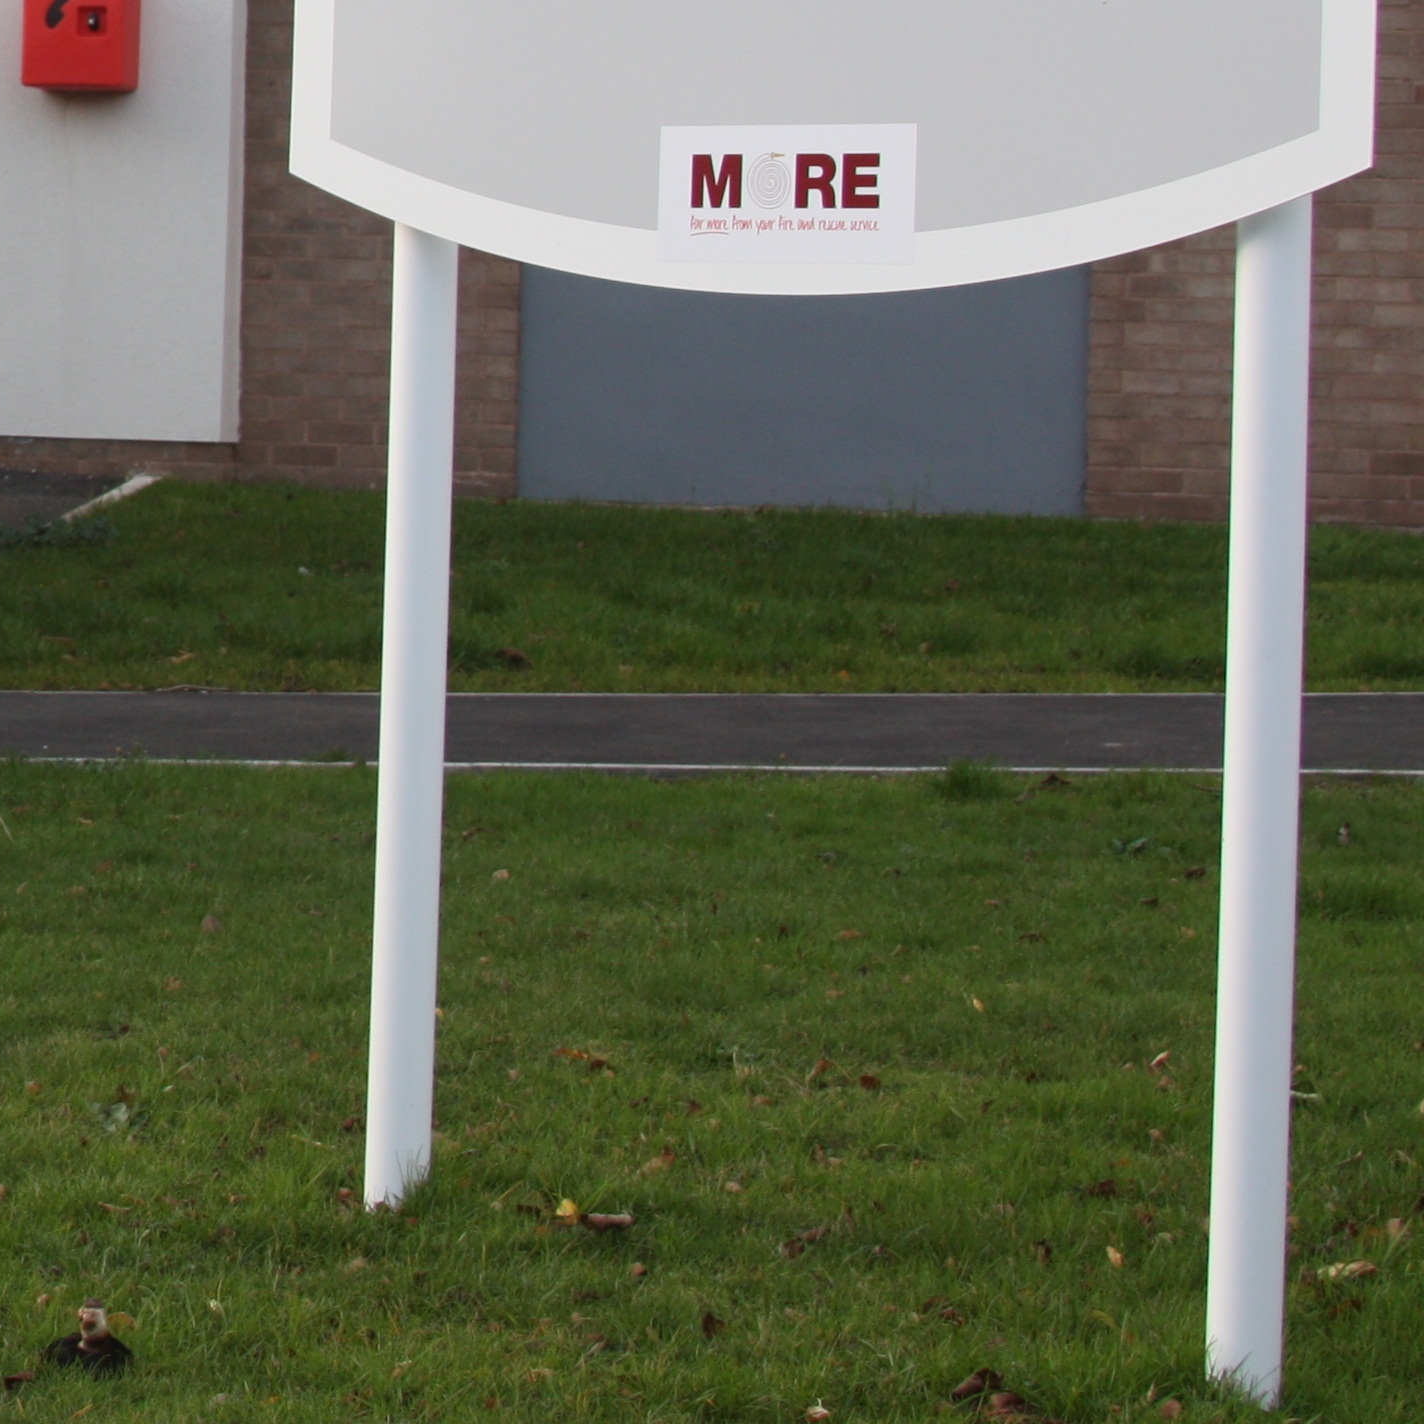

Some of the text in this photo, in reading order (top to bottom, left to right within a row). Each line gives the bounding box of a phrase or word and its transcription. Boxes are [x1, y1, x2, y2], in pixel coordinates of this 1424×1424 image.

[690, 151, 881, 209] MORE
[707, 218, 729, 231] more
[756, 219, 775, 235] your
[797, 217, 815, 231] and
[818, 219, 847, 231] rescue
[849, 217, 880, 231] service
